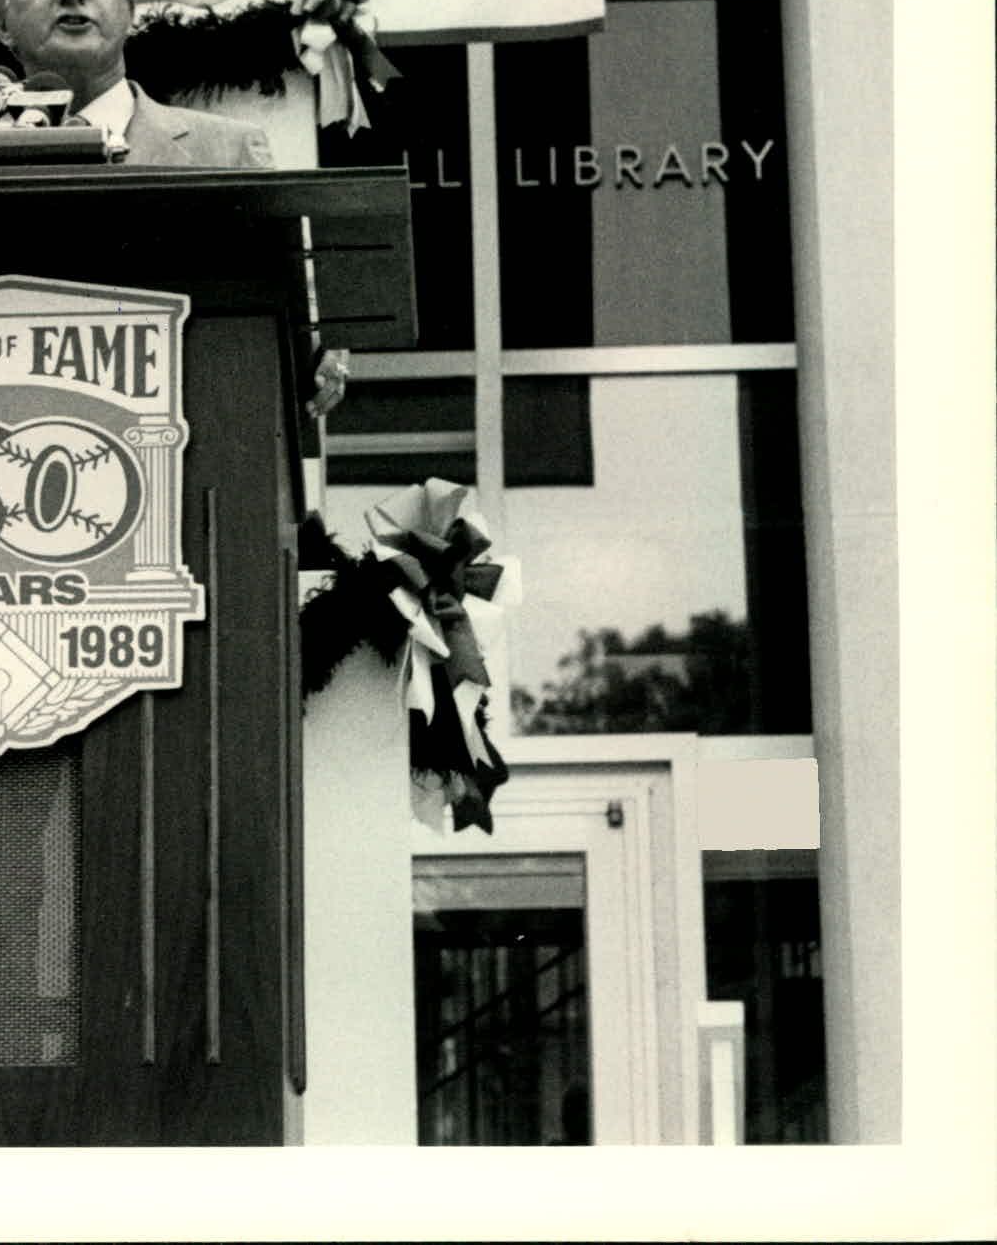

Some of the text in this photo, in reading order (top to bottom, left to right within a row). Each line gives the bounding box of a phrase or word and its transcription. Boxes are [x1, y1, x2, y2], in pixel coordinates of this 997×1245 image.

[515, 139, 775, 188] LIBRARY
[29, 324, 160, 398] FAME
[59, 624, 165, 669] 1989
